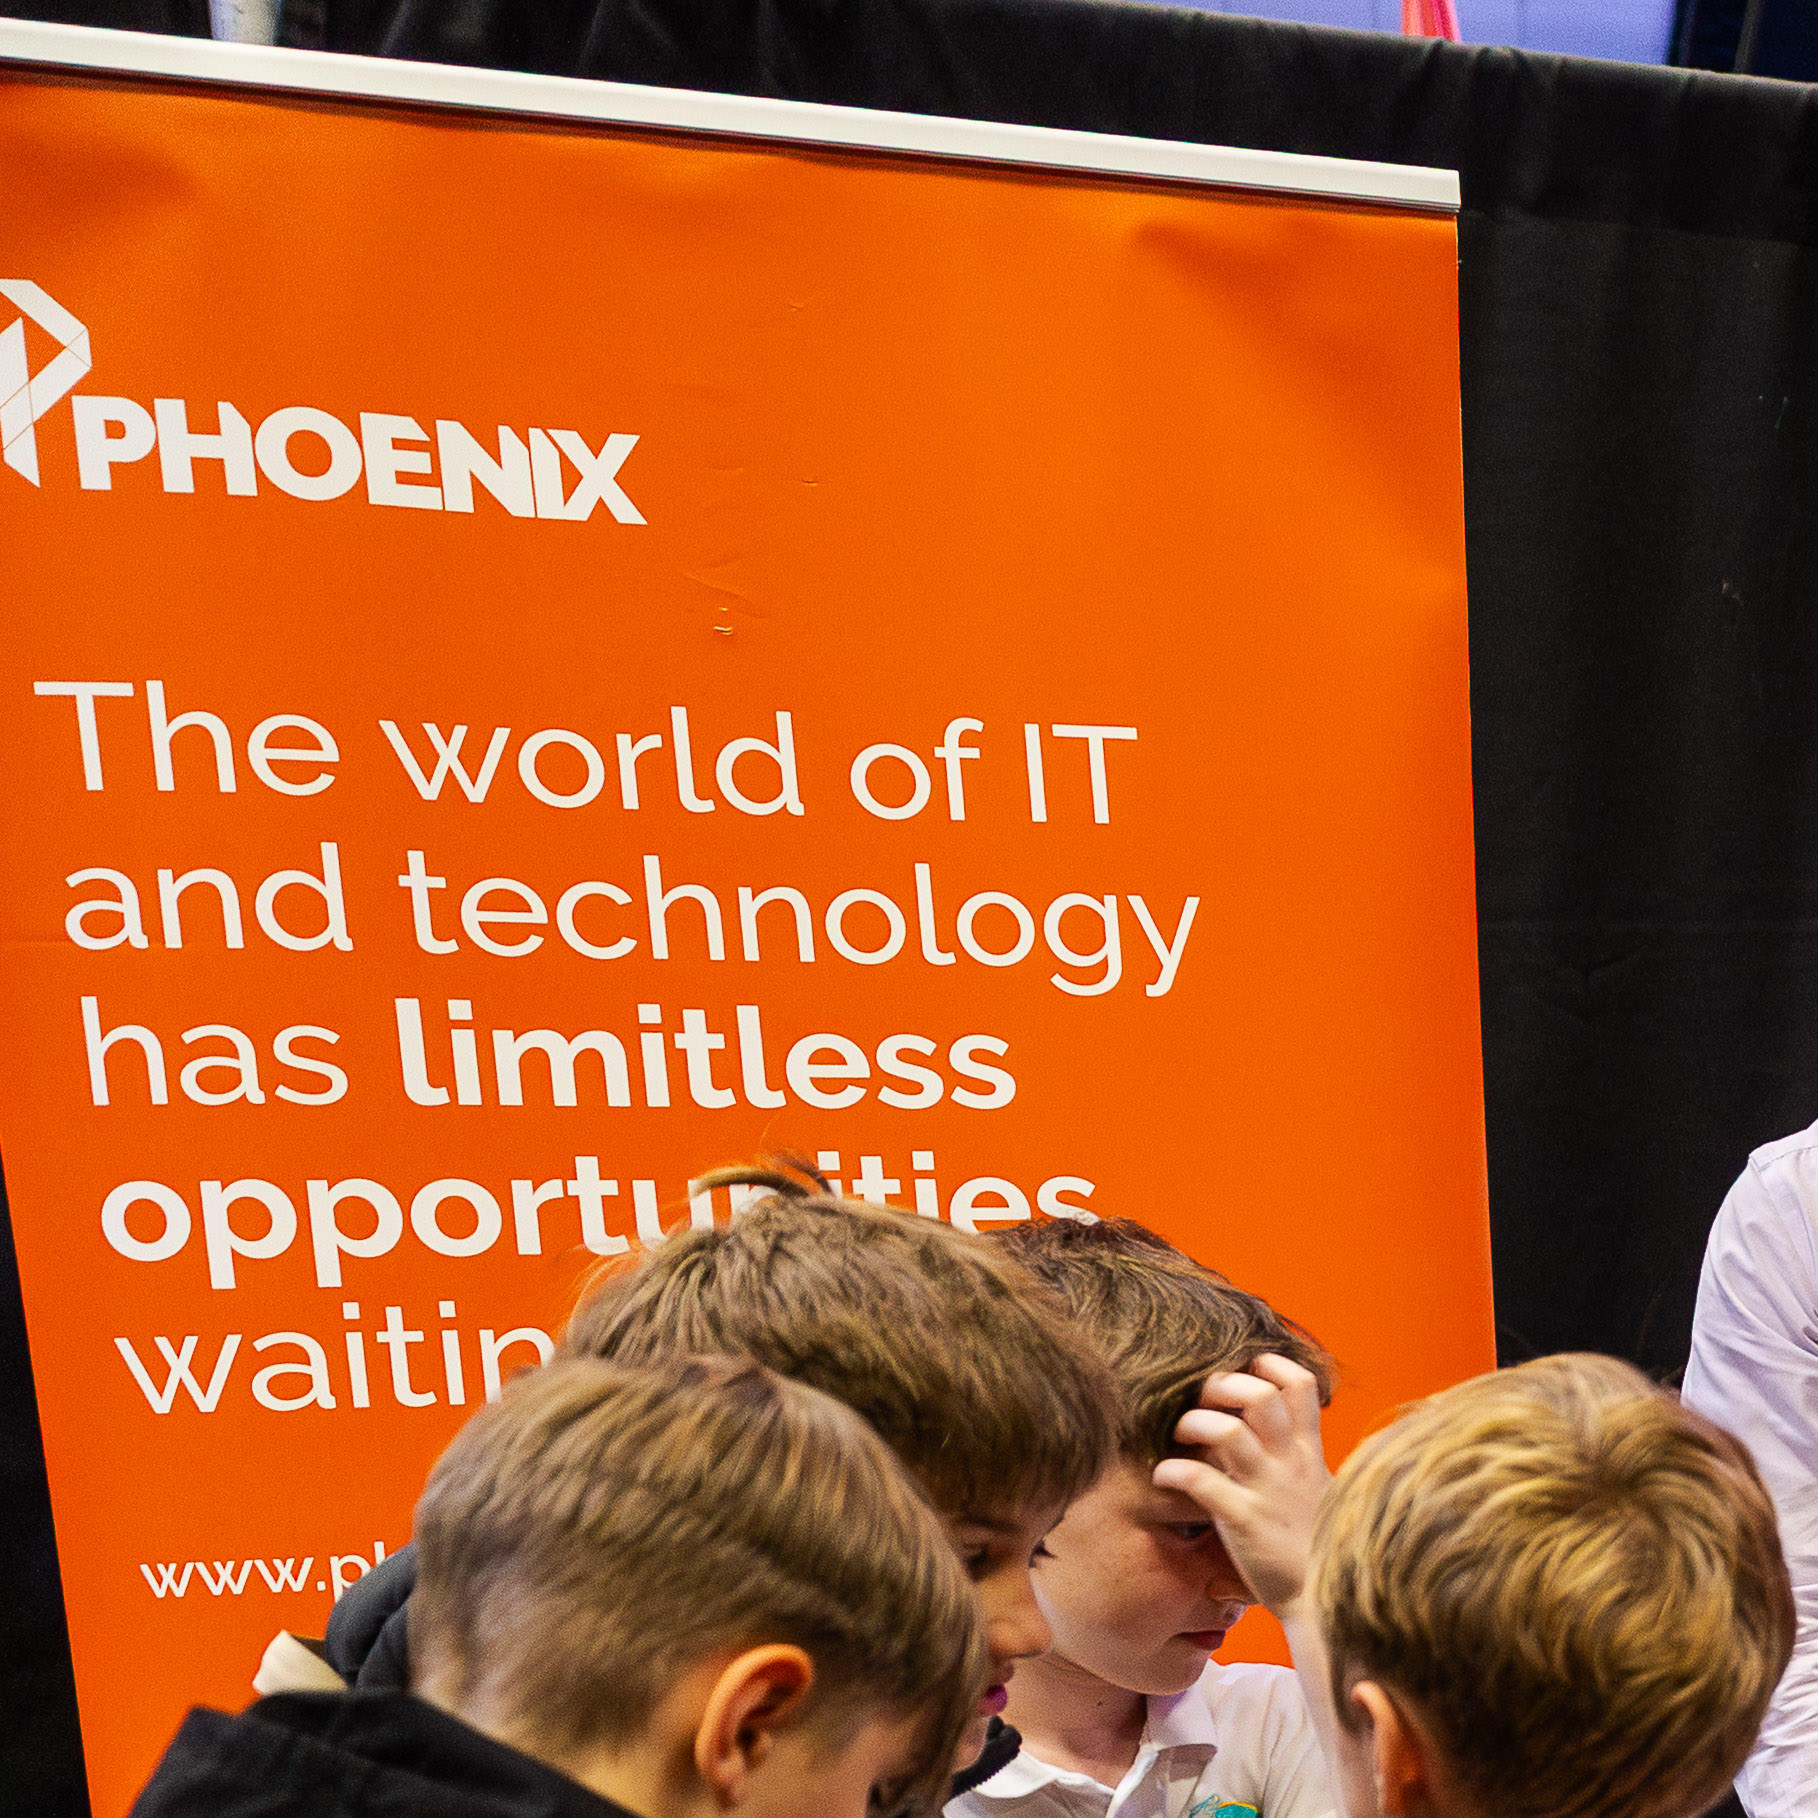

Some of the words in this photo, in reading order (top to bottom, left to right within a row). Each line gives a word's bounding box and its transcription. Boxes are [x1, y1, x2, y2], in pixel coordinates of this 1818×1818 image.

[71, 395, 647, 525] PHOENIX
[33, 680, 340, 796] The
[379, 706, 805, 816] world
[850, 717, 984, 821] of
[1024, 723, 1138, 824] IT
[65, 841, 354, 952] and
[395, 850, 1200, 999] technology
[81, 996, 348, 1106] has
[395, 998, 1016, 1110] limitless
[114, 1300, 555, 1415] waitin
